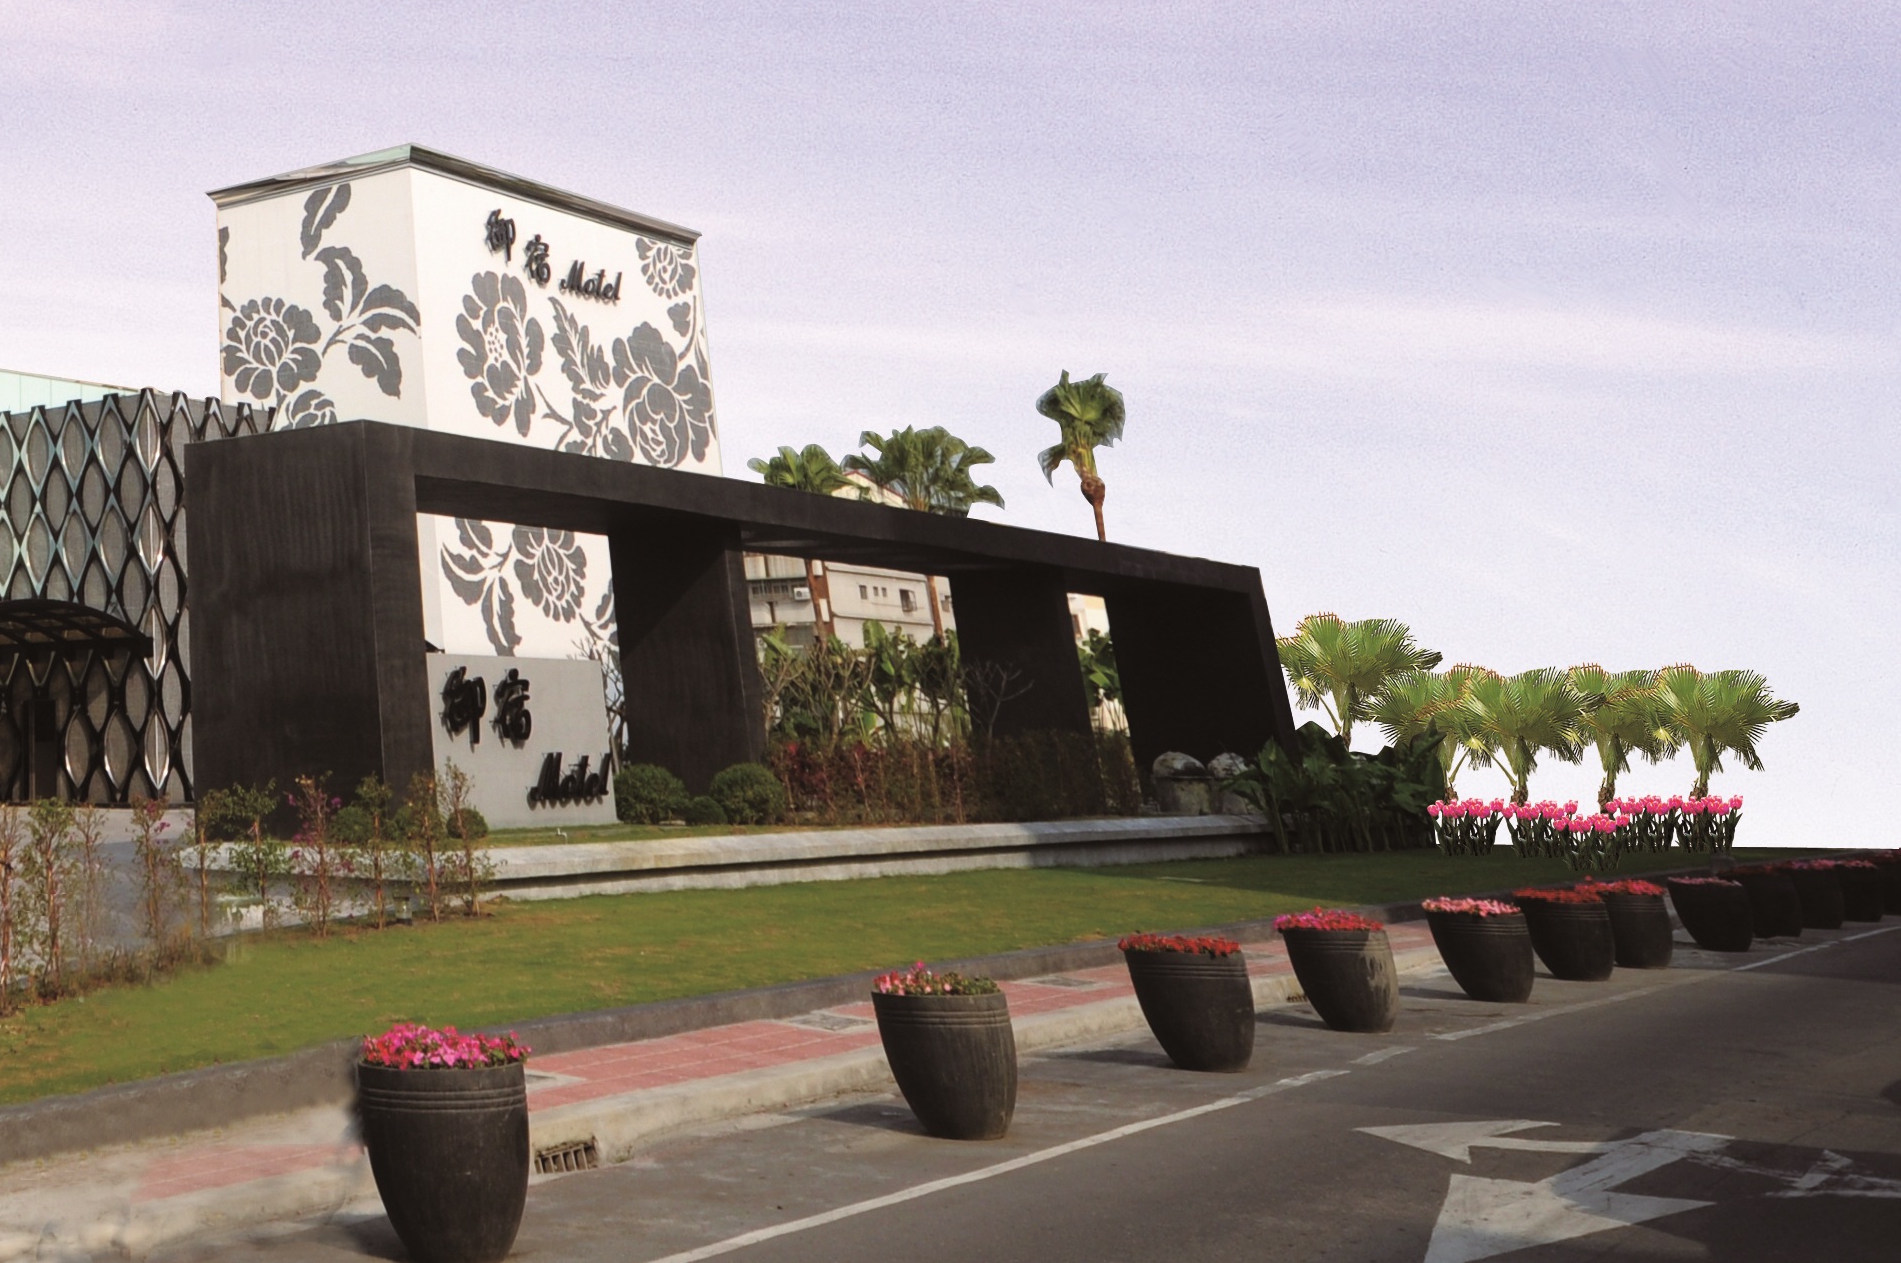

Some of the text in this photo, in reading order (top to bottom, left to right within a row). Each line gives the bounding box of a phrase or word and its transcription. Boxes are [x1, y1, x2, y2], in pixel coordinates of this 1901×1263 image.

[559, 259, 622, 304] Motel
[442, 666, 532, 745] 御宿
[527, 752, 612, 804] Motel
